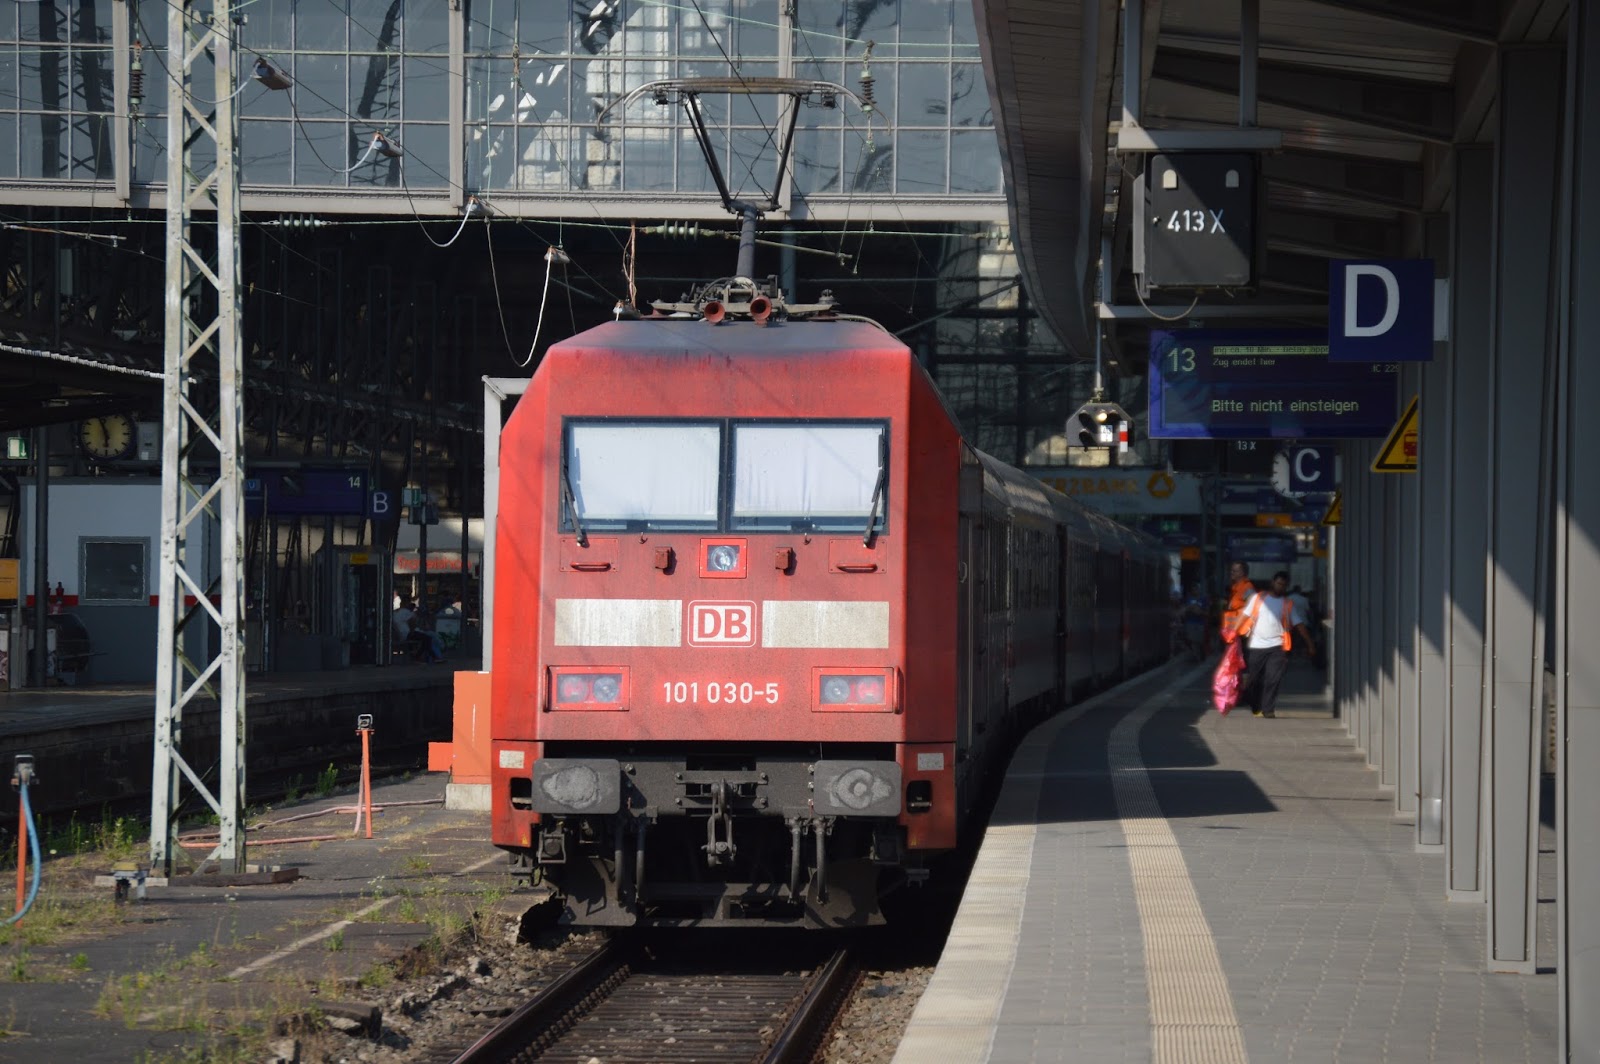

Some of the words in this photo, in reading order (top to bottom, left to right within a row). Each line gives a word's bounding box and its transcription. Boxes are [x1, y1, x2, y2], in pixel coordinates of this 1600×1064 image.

[1344, 264, 1400, 337] D
[1167, 347, 1196, 373] 13
[1213, 358, 1229, 367] Zug
[1232, 358, 1256, 366] endet
[1260, 358, 1276, 366] hier
[1212, 399, 1244, 412] Bitte
[1250, 399, 1283, 412] nicht
[1290, 399, 1359, 415] einsteigen
[1295, 448, 1321, 483] C
[348, 476, 361, 488] 14
[373, 492, 389, 513] B
[697, 608, 748, 639] DB
[663, 681, 698, 704] 101
[706, 681, 779, 704] 030-5
